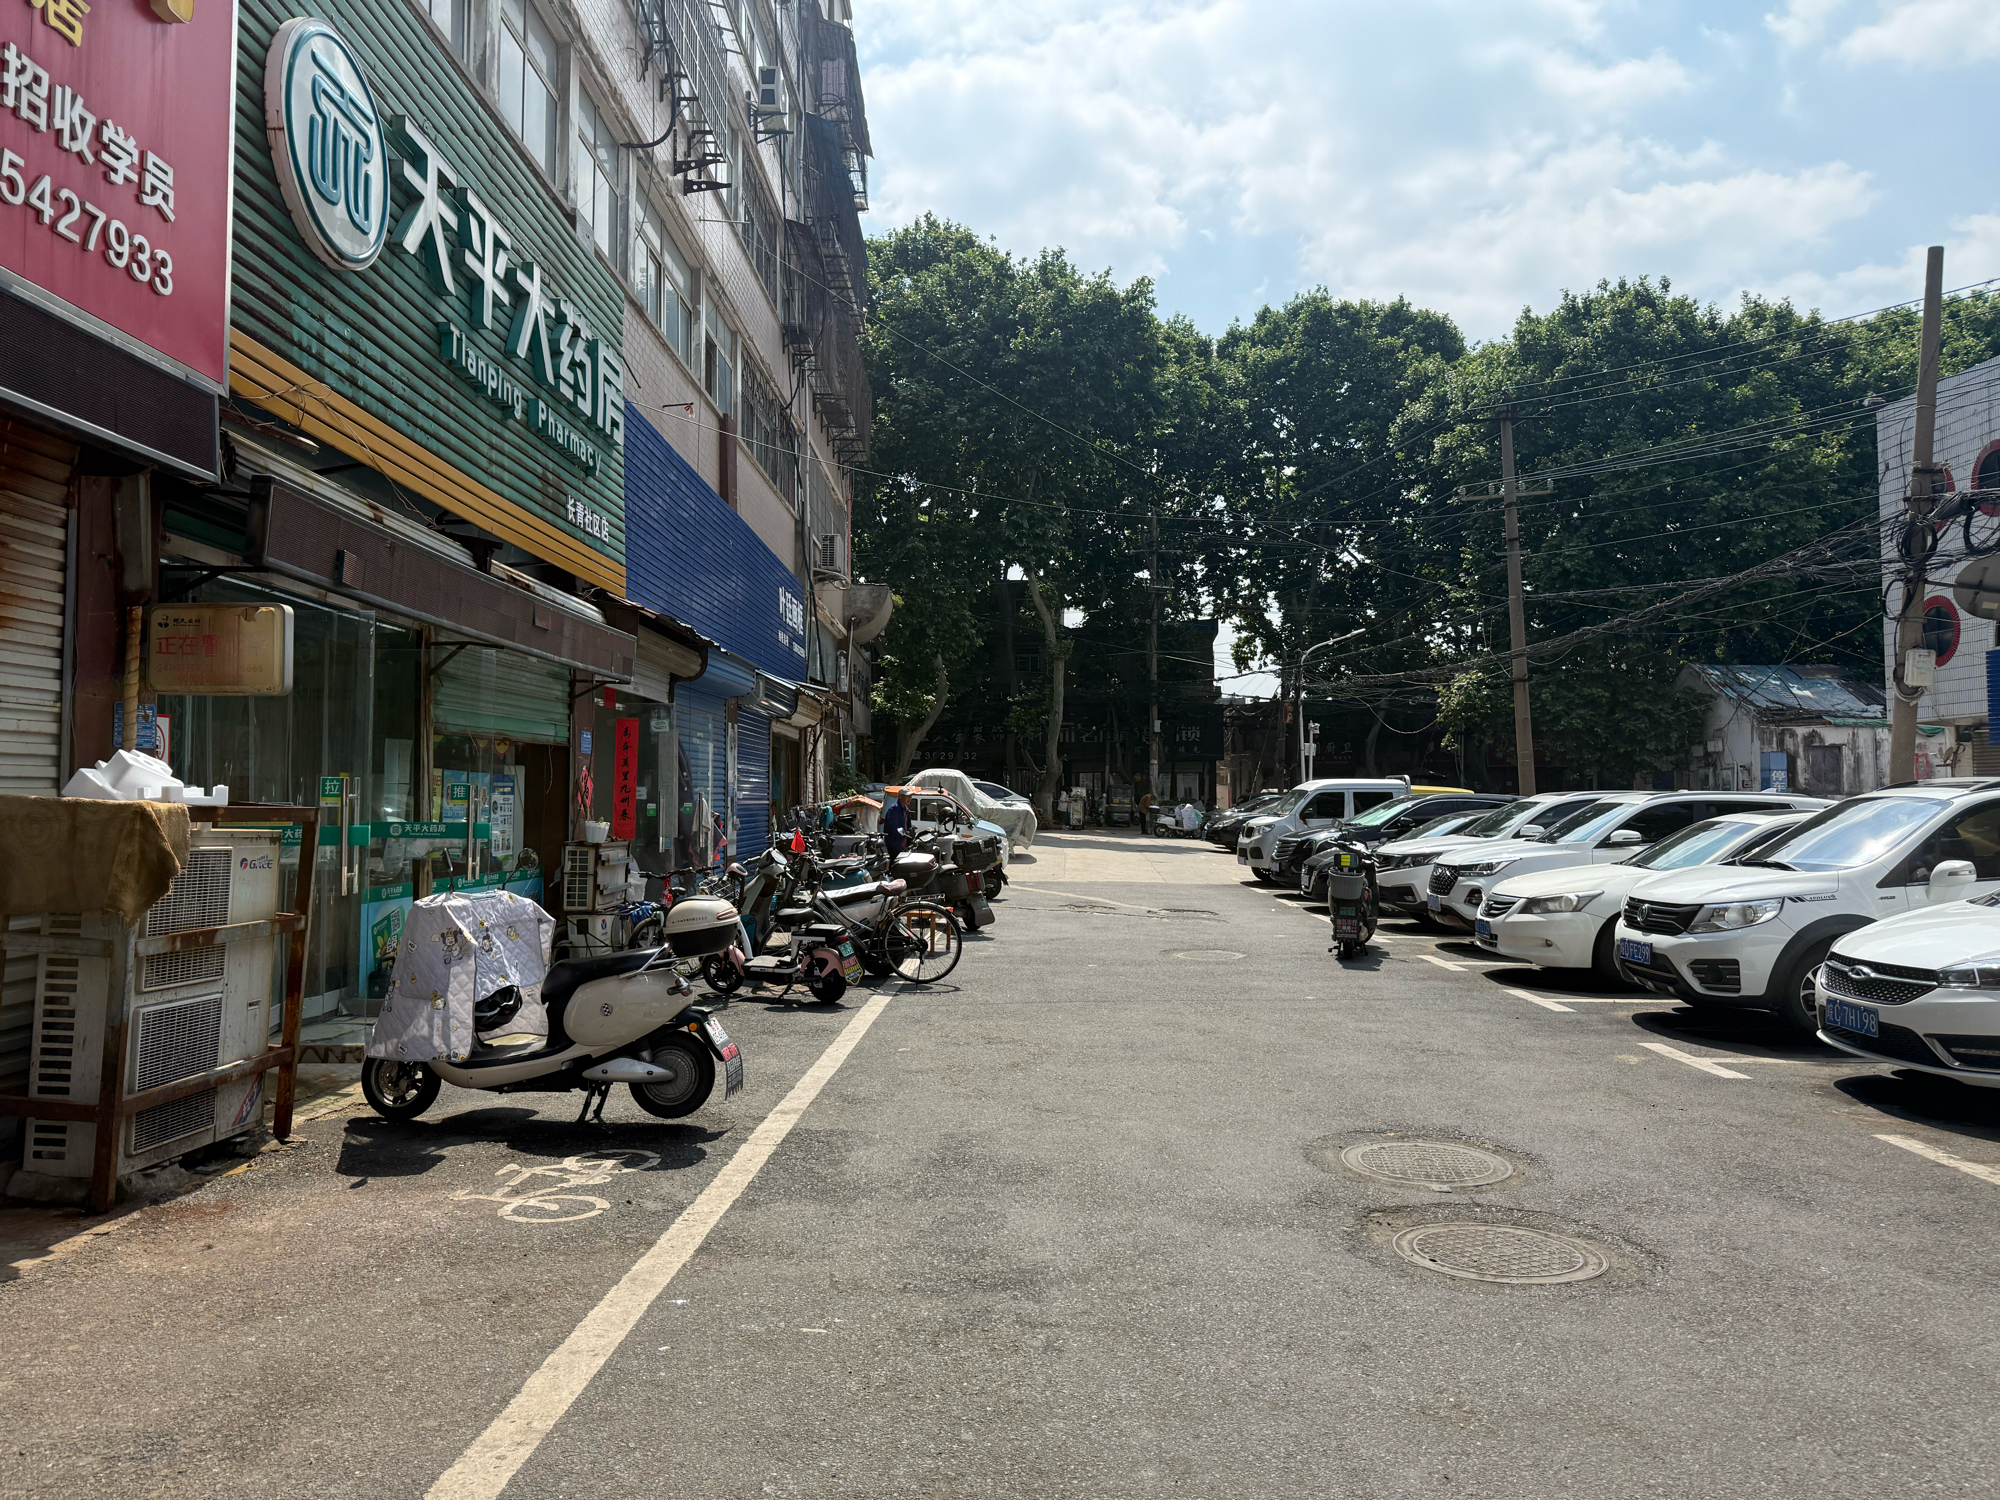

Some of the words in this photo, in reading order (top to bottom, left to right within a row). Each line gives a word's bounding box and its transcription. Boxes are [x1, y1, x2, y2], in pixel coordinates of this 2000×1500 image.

[2, 41, 176, 222] 招收学员
[0, 147, 174, 296] 5427933
[398, 115, 624, 447] 天平大药房
[536, 399, 601, 474] Pharmacy
[565, 495, 609, 543] 长青社区店
[924, 751, 977, 761] 32932
[325, 780, 340, 795] 拉
[453, 786, 466, 798] 推
[1771, 770, 1786, 792] 停车
[404, 824, 446, 833] 天平大药房
